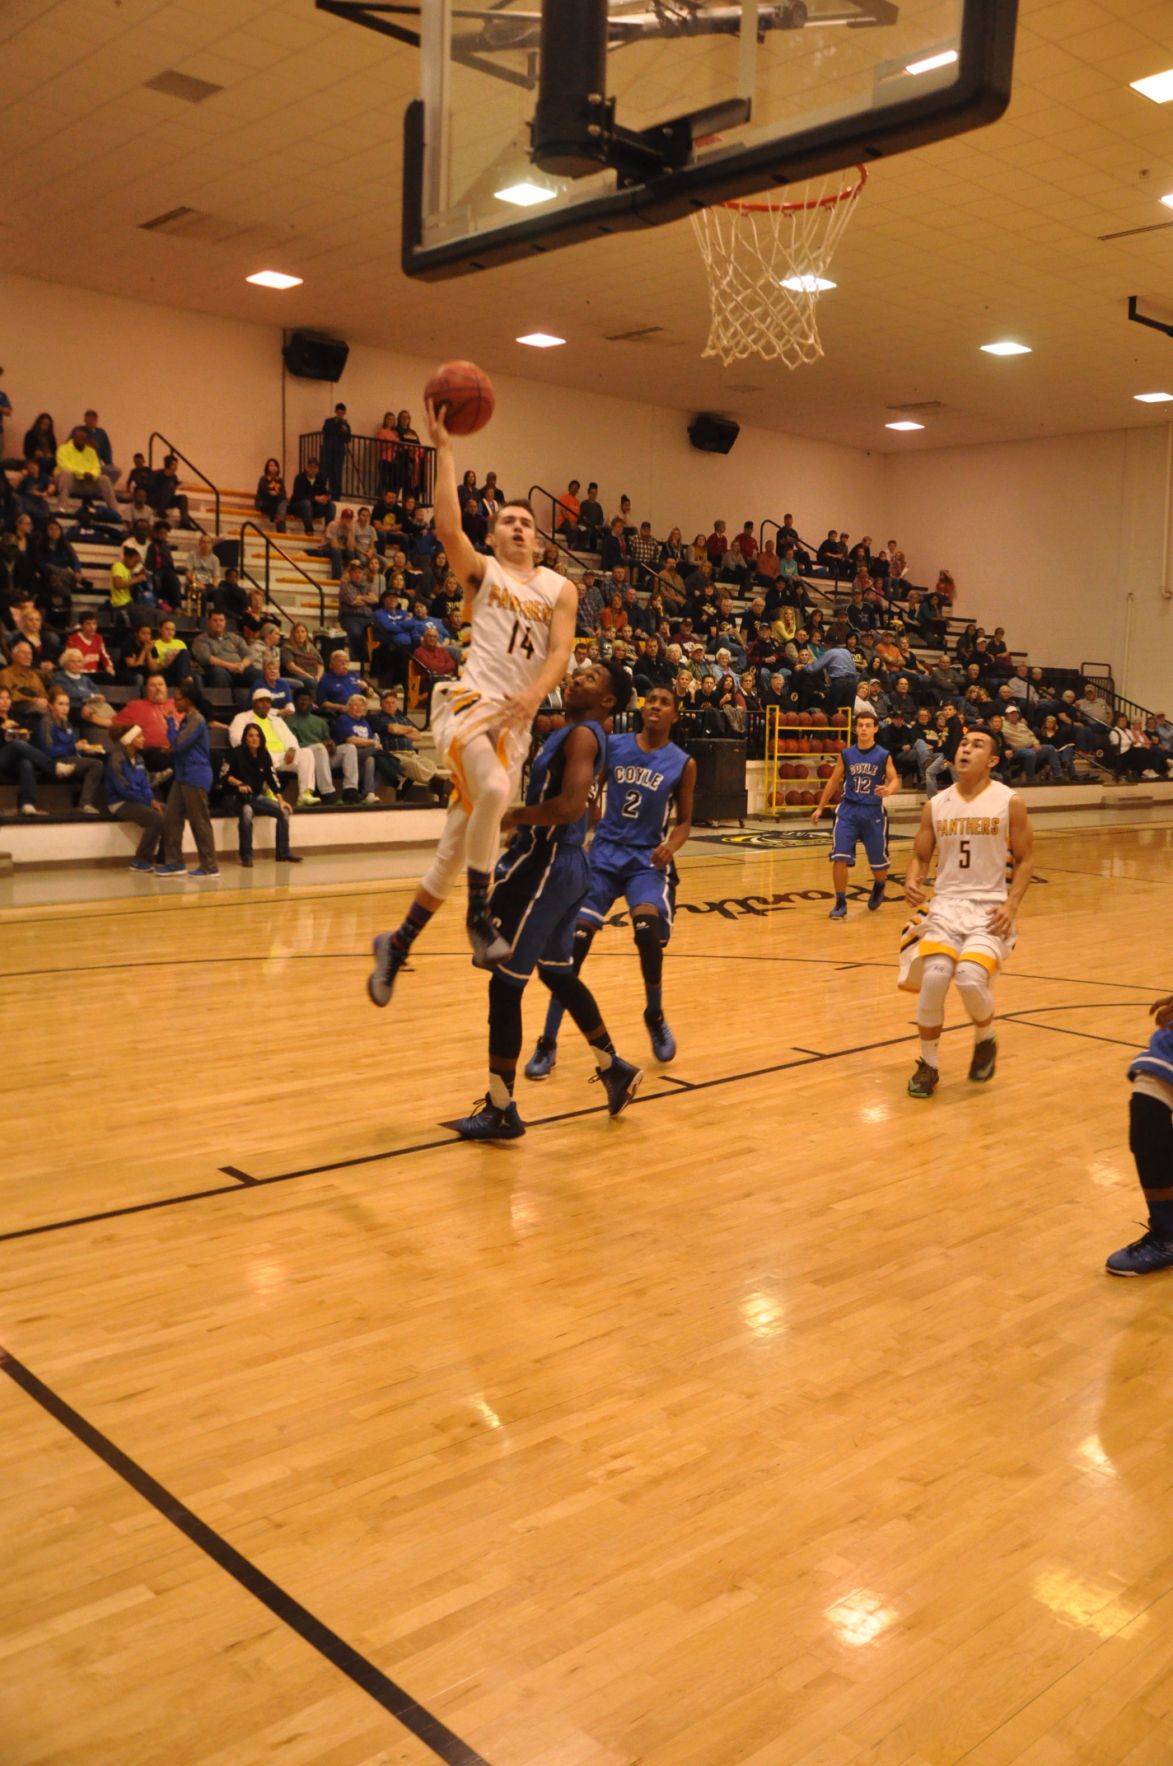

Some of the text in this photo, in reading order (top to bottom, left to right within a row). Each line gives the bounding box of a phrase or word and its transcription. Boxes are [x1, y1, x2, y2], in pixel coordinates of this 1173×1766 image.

[507, 618, 535, 660] 14
[615, 766, 664, 791] COYLE
[853, 776, 871, 794] 12
[622, 790, 642, 819] 2
[936, 817, 1000, 836] PANTHERS
[959, 840, 970, 869] 5
